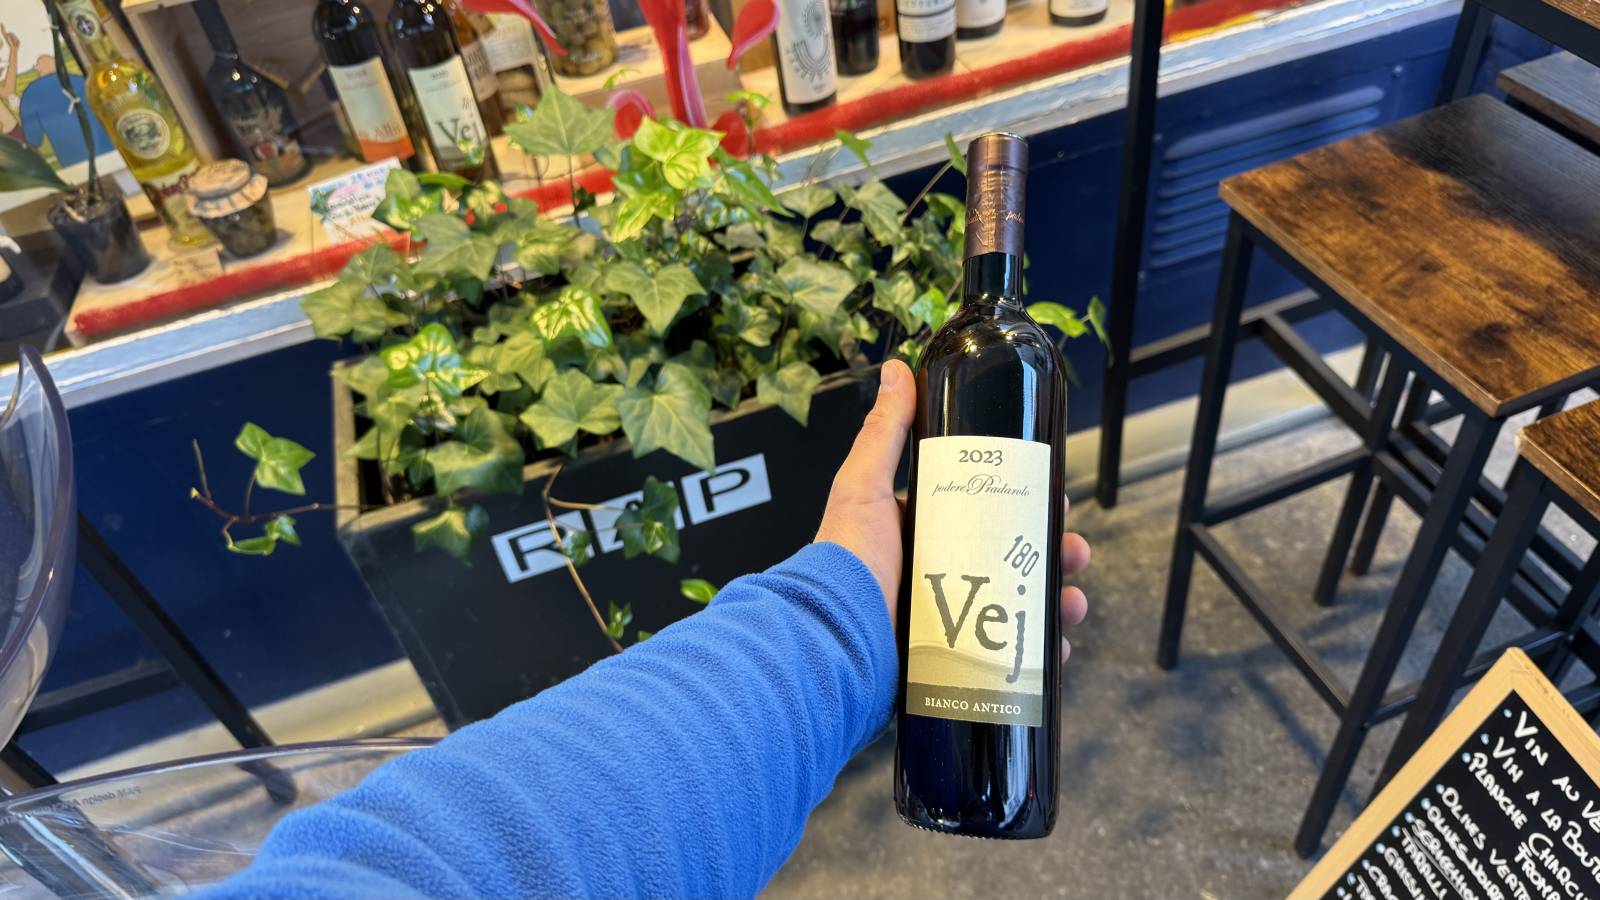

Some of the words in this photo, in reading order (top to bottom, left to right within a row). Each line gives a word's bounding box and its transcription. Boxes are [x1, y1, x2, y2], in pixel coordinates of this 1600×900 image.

[931, 480, 968, 497] podere
[966, 473, 1031, 497] Pradarolo
[958, 449, 1003, 466] 2023
[1003, 535, 1040, 577] 180
[924, 573, 1026, 683] Vej
[924, 697, 969, 710] BIANCO
[973, 702, 1022, 715] ANTICO
[1492, 736, 1524, 784] VIN
[1525, 790, 1540, 806] A
[1540, 808, 1562, 832] LA
[1514, 710, 1549, 767] VIN
[1551, 776, 1580, 802] AU
[1441, 786, 1487, 850] OLIVES
[1469, 752, 1528, 830] PLANCHE
